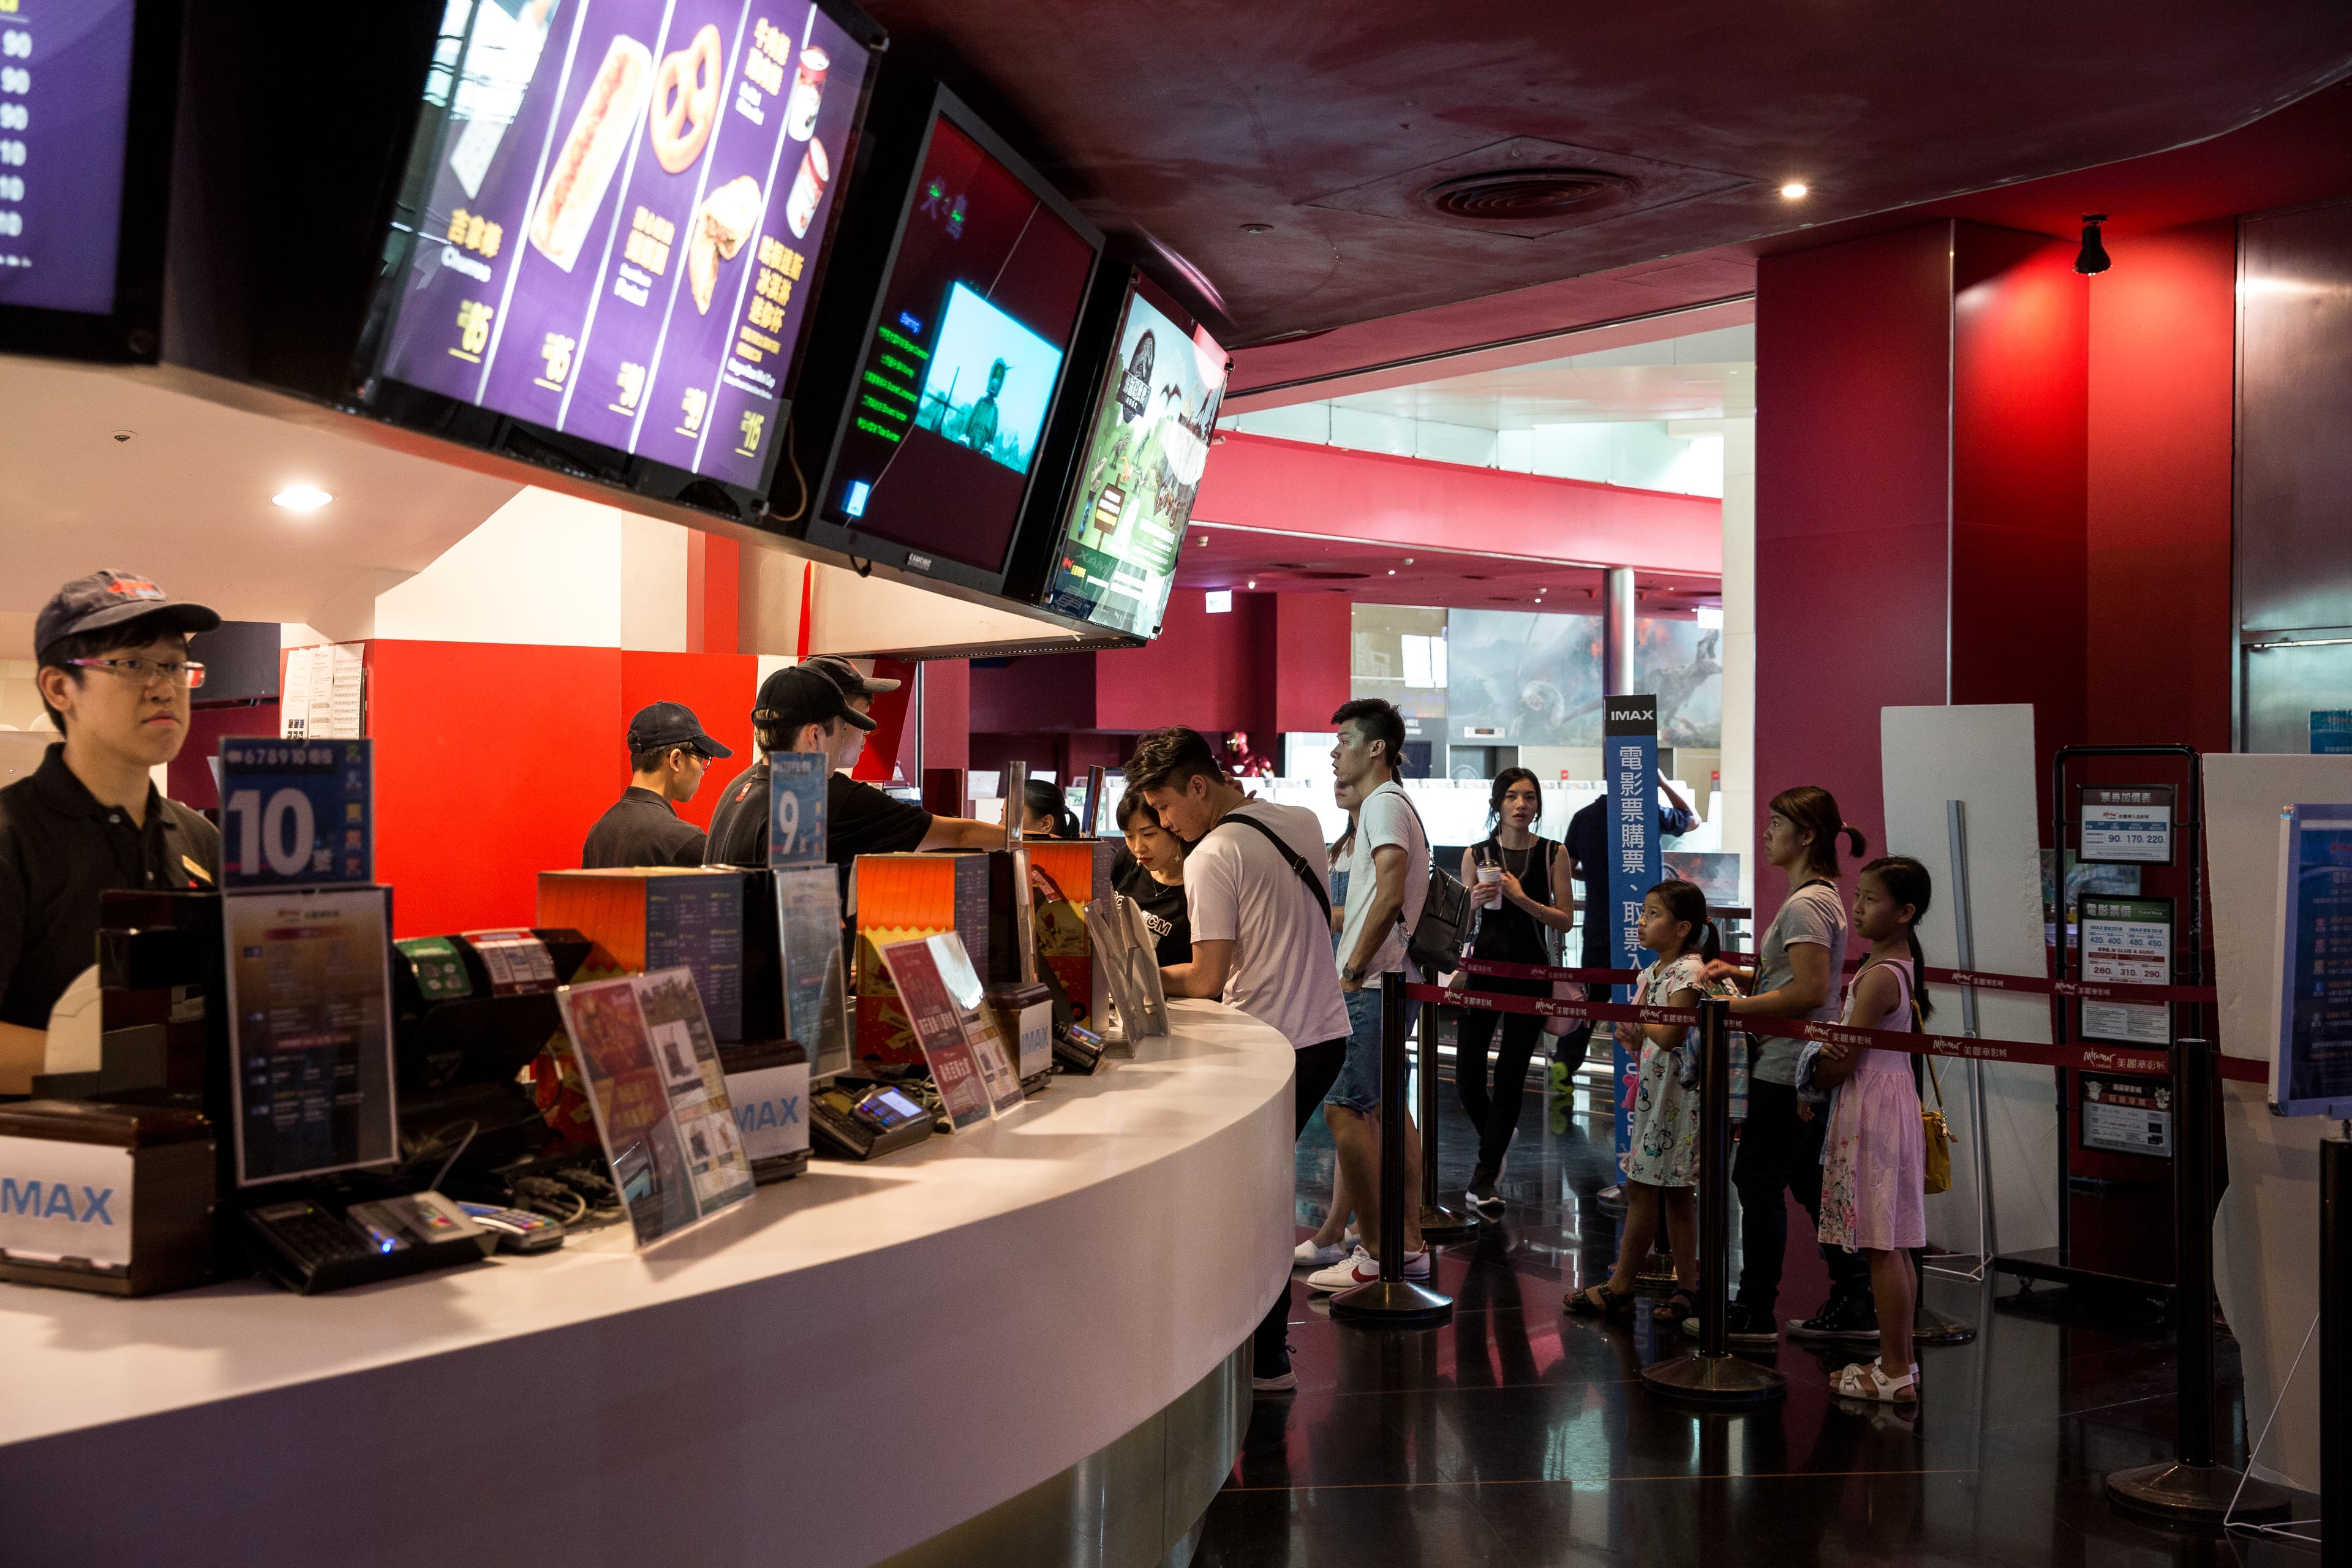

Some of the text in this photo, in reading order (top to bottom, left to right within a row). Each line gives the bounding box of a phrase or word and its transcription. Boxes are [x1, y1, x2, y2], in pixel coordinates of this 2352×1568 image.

[1611, 710, 1654, 721] IMAX
[227, 787, 315, 876] 10
[778, 790, 799, 854] 9
[2127, 835, 2143, 843] 170
[2087, 903, 2132, 918] 電影票價
[1444, 988, 1492, 1007] Miramar 美麗華影城
[1536, 998, 1587, 1016] Miramar 美麗華影城
[1640, 1006, 1696, 1023] Miramar 美麗華影城
[1804, 1020, 1872, 1045] Miramar 美麗華影城
[1933, 1036, 2007, 1058] Miramar 美麗華影城
[2084, 1048, 2166, 1069] Miramar 美麗華影城
